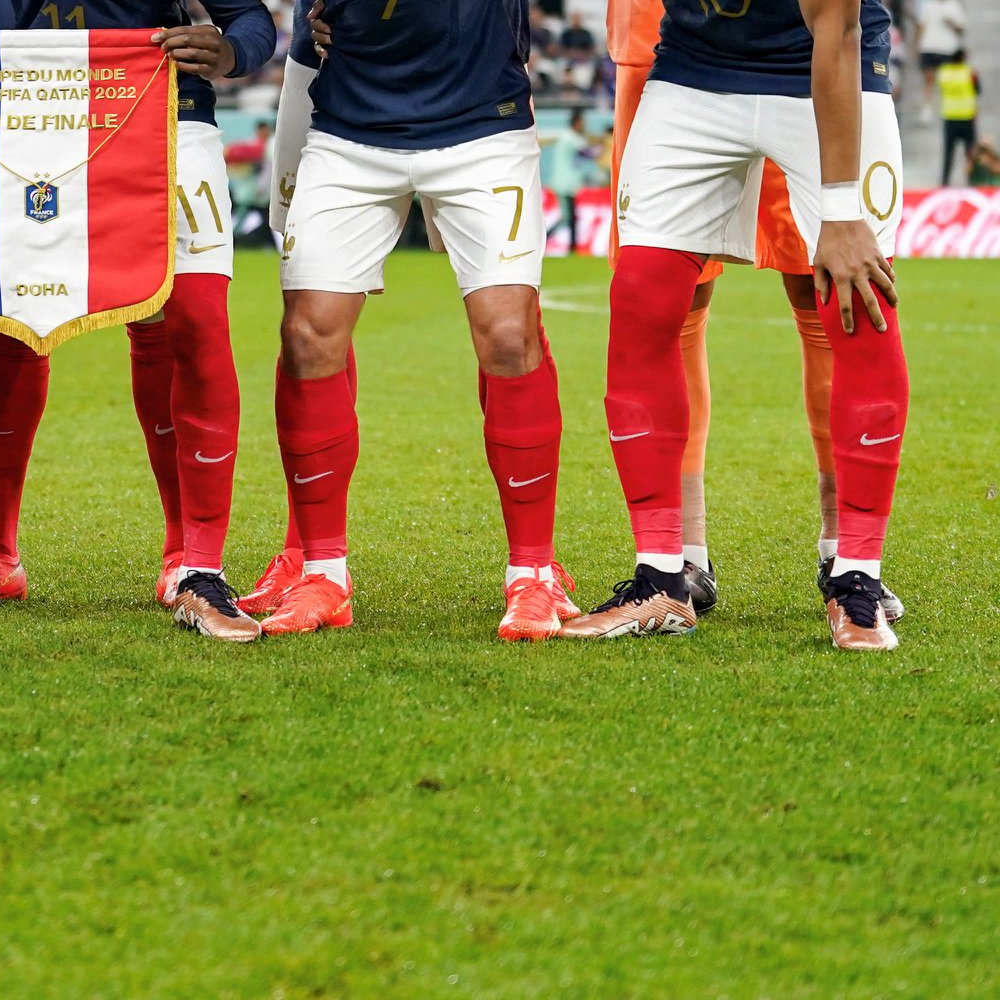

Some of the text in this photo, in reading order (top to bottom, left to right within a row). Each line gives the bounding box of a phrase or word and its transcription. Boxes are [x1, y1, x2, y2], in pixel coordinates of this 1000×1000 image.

[27, 69, 53, 82] DU
[56, 68, 126, 82] MONDE
[36, 88, 91, 101] QATAR
[94, 86, 137, 99] 2022
[6, 114, 37, 130] DE
[41, 113, 120, 131] FINALE
[862, 160, 898, 221] 0
[177, 180, 224, 234] 11
[491, 185, 524, 242] 7
[15, 283, 69, 297] DOHA
[598, 611, 687, 638] AIR
